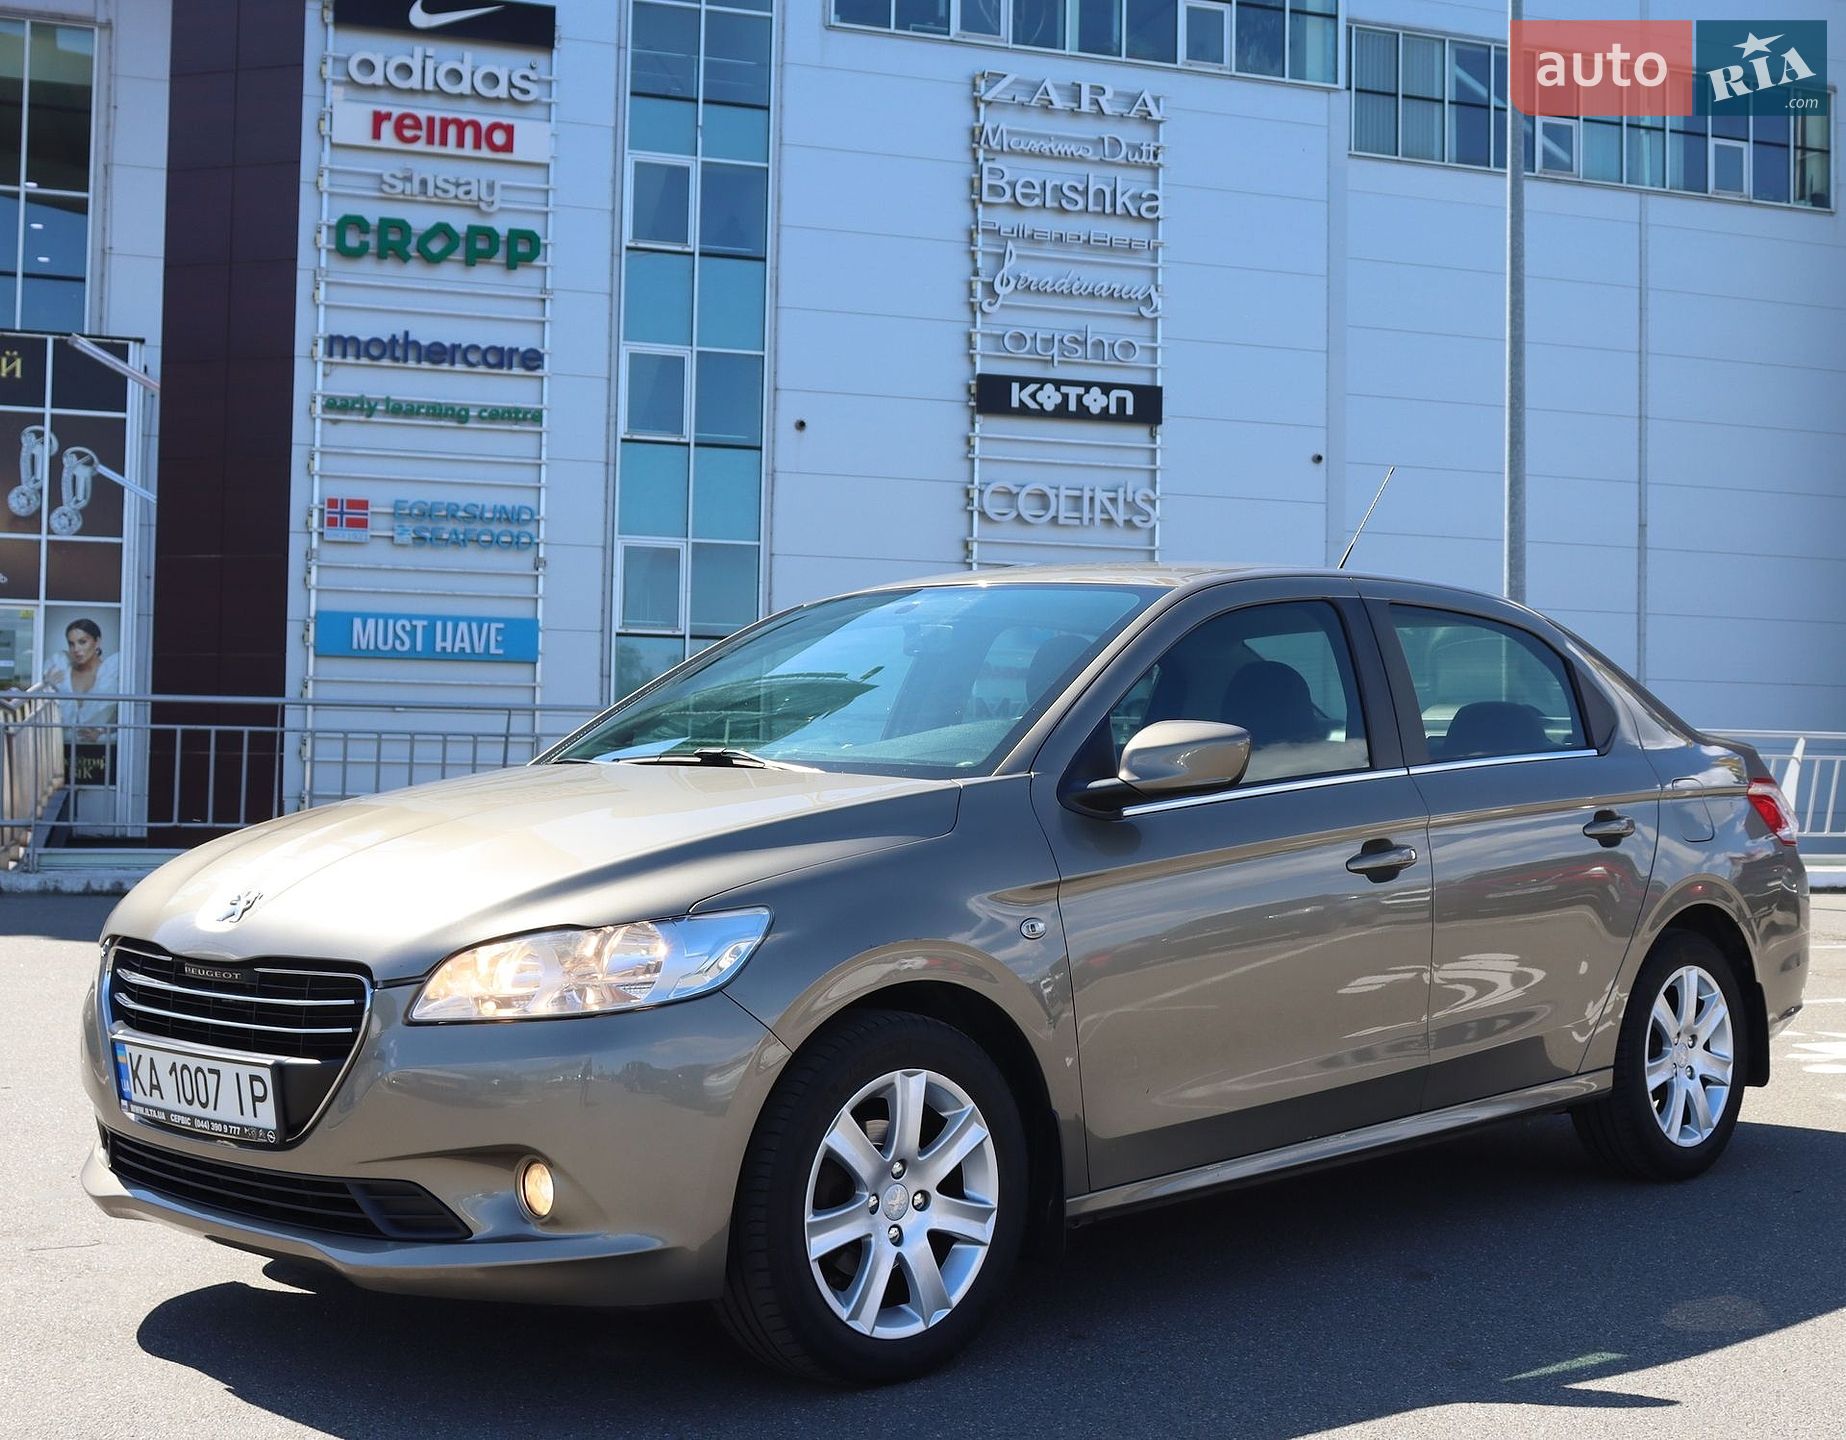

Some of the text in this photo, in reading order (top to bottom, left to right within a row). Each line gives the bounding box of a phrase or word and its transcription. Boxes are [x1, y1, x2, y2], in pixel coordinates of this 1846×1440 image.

[347, 46, 539, 102] adidas
[980, 69, 1166, 123] ZARA
[371, 109, 515, 153] reima
[980, 121, 1093, 158] Massimo
[380, 166, 501, 213] sinsay
[980, 162, 1162, 220] Bershka
[335, 214, 541, 271] CROPP
[978, 219, 1028, 240] Pull
[327, 330, 544, 371] mothercare
[1002, 324, 1140, 367] oysho
[325, 394, 543, 425] early learning centre
[1011, 382, 1134, 416] KOTON
[394, 499, 535, 526] EGERSUND
[983, 480, 1158, 529] COLIN'S
[411, 525, 534, 551] SEAFOOD
[352, 617, 505, 655] MUST HAVE
[184, 965, 241, 980] PEUGEOT
[129, 1052, 268, 1118] KA 1007 IP
